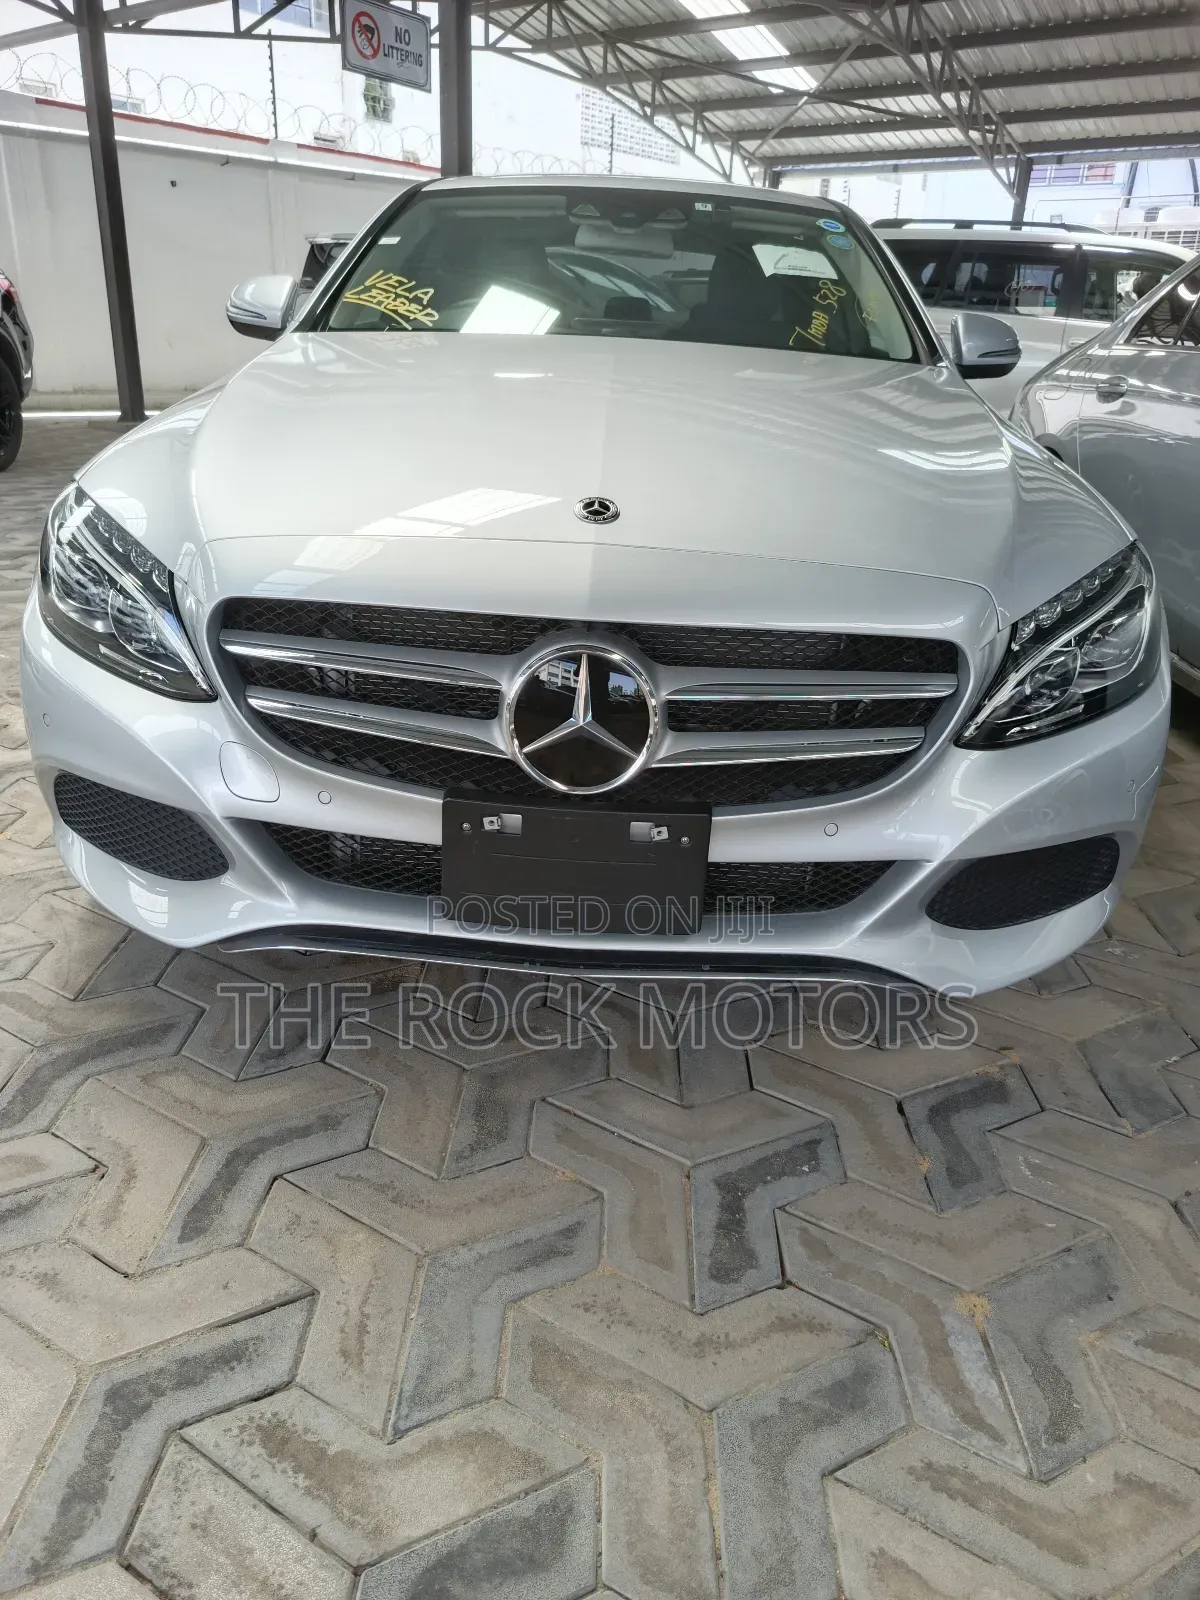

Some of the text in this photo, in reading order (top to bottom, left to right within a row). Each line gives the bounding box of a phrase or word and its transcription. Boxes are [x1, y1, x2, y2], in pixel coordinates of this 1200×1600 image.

[395, 26, 411, 47] NO
[383, 43, 423, 68] LITTERING
[364, 270, 434, 305] VELA
[812, 279, 847, 315] 528
[344, 285, 440, 327] LEADER
